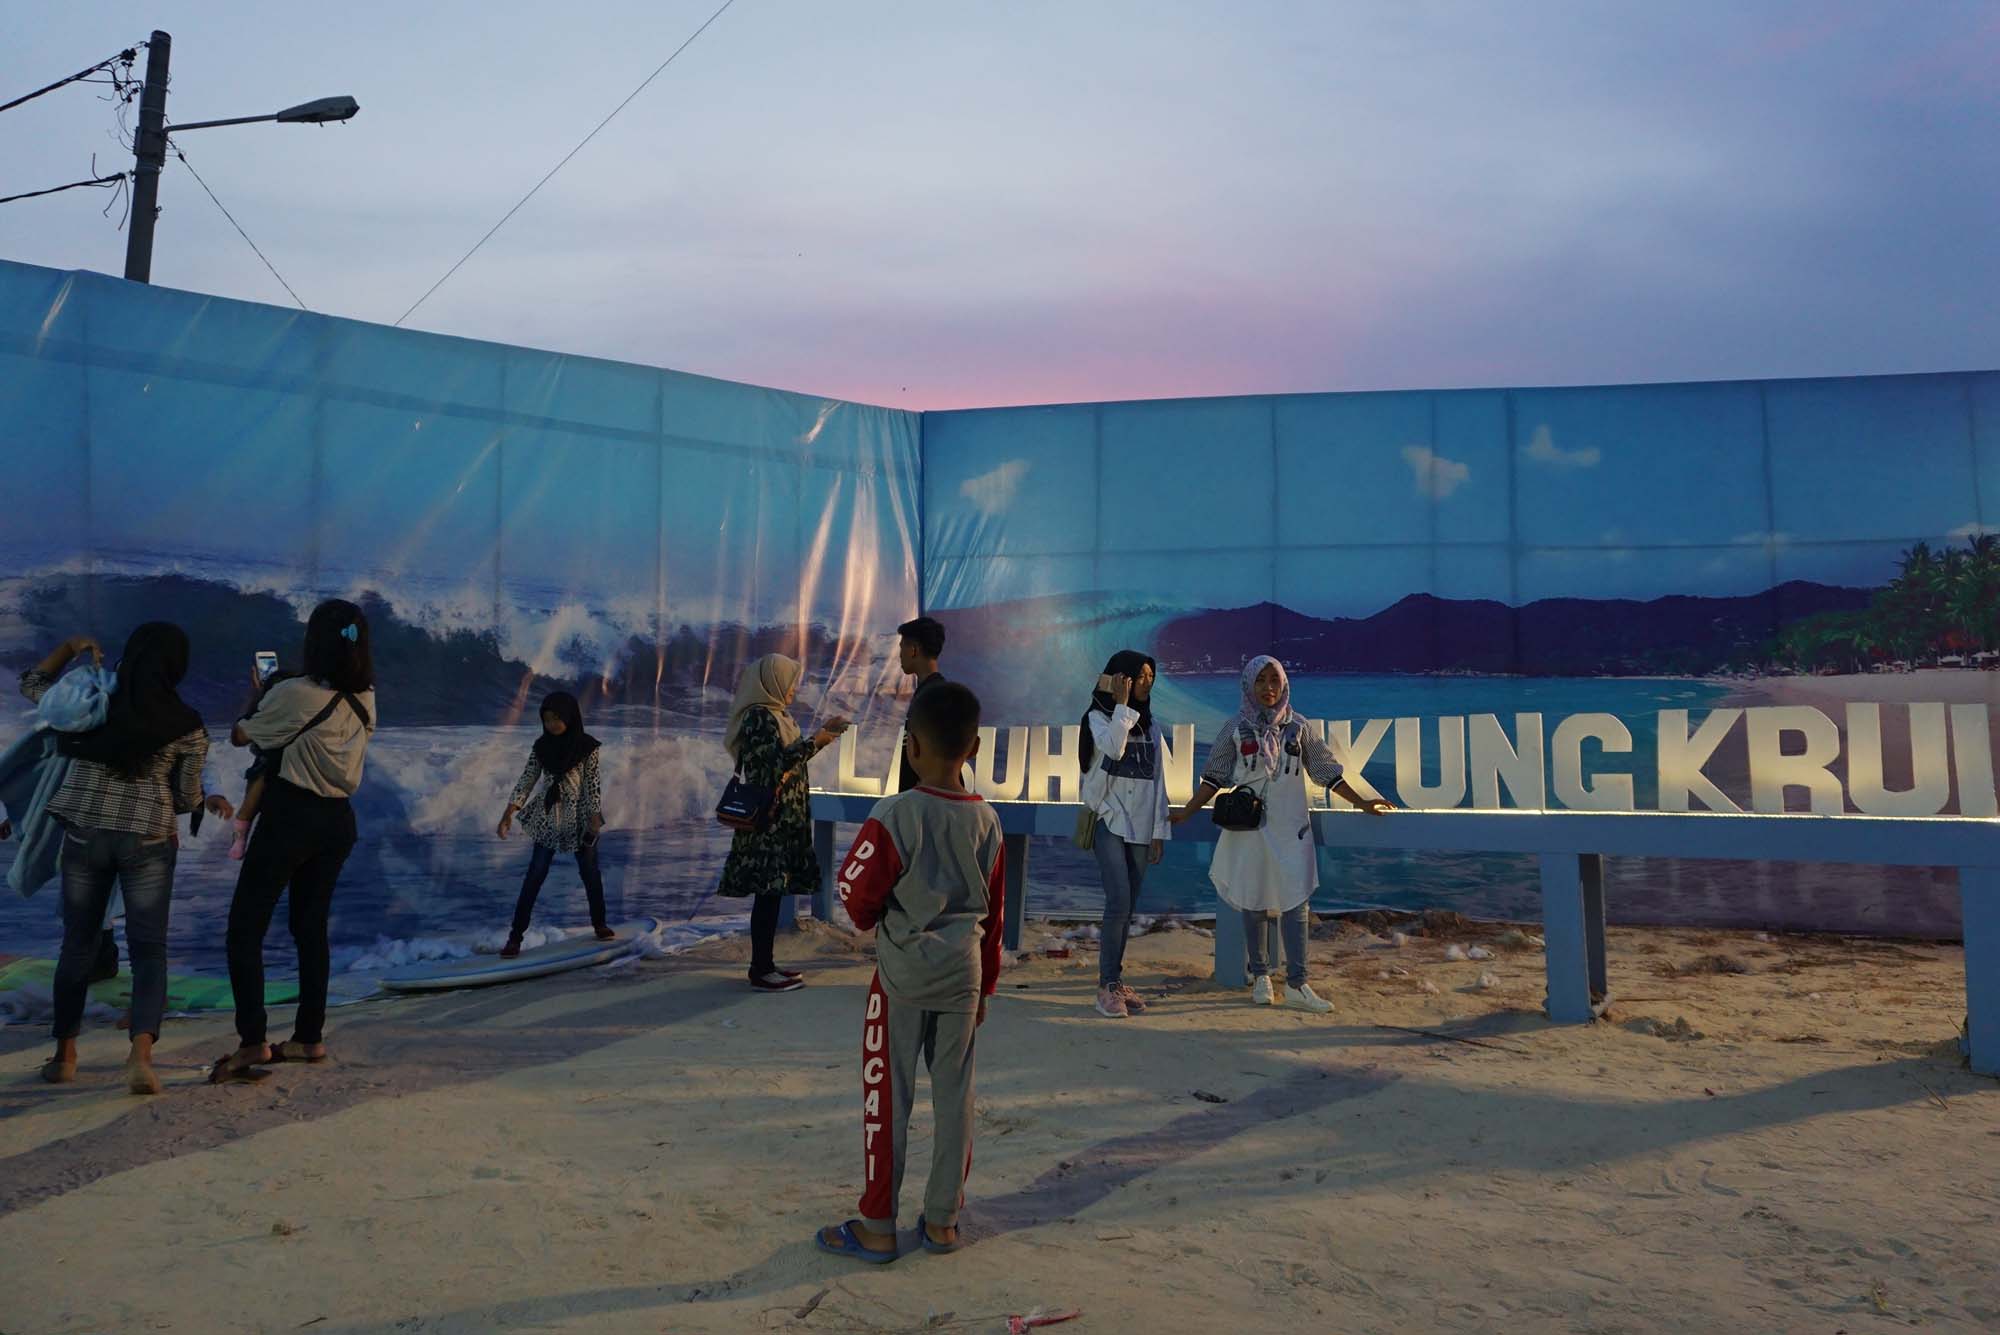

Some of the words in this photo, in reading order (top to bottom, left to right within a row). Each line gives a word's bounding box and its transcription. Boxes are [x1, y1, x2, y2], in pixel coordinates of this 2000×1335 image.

[839, 723, 1195, 806] LUHN
[1200, 711, 1633, 811] KUNG
[1658, 702, 1998, 817] KRUI
[864, 993, 883, 1181] DUCATI
